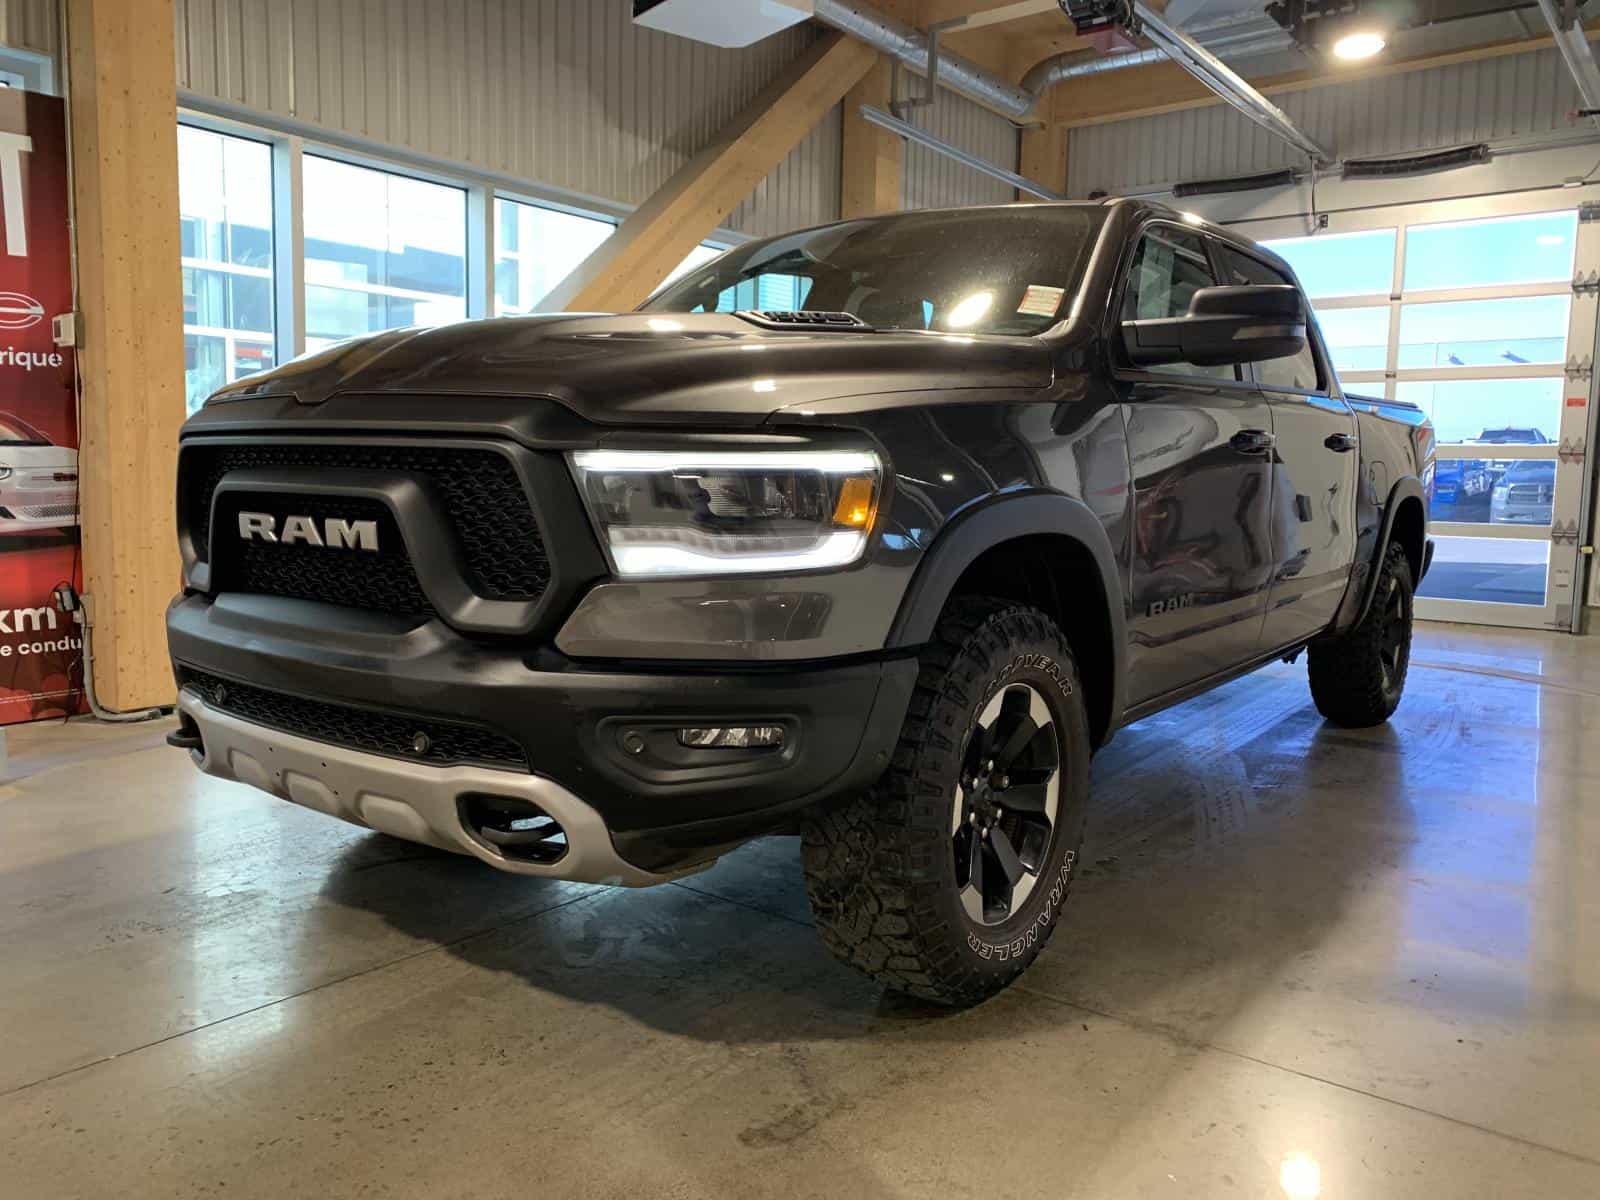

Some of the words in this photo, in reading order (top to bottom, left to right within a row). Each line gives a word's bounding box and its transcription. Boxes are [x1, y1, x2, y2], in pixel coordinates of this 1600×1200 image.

[0, 346, 63, 371] rique
[238, 510, 379, 552] RAM
[1146, 592, 1194, 617] RAM
[18, 635, 82, 655] condu
[967, 850, 1075, 961] WRANGLER
